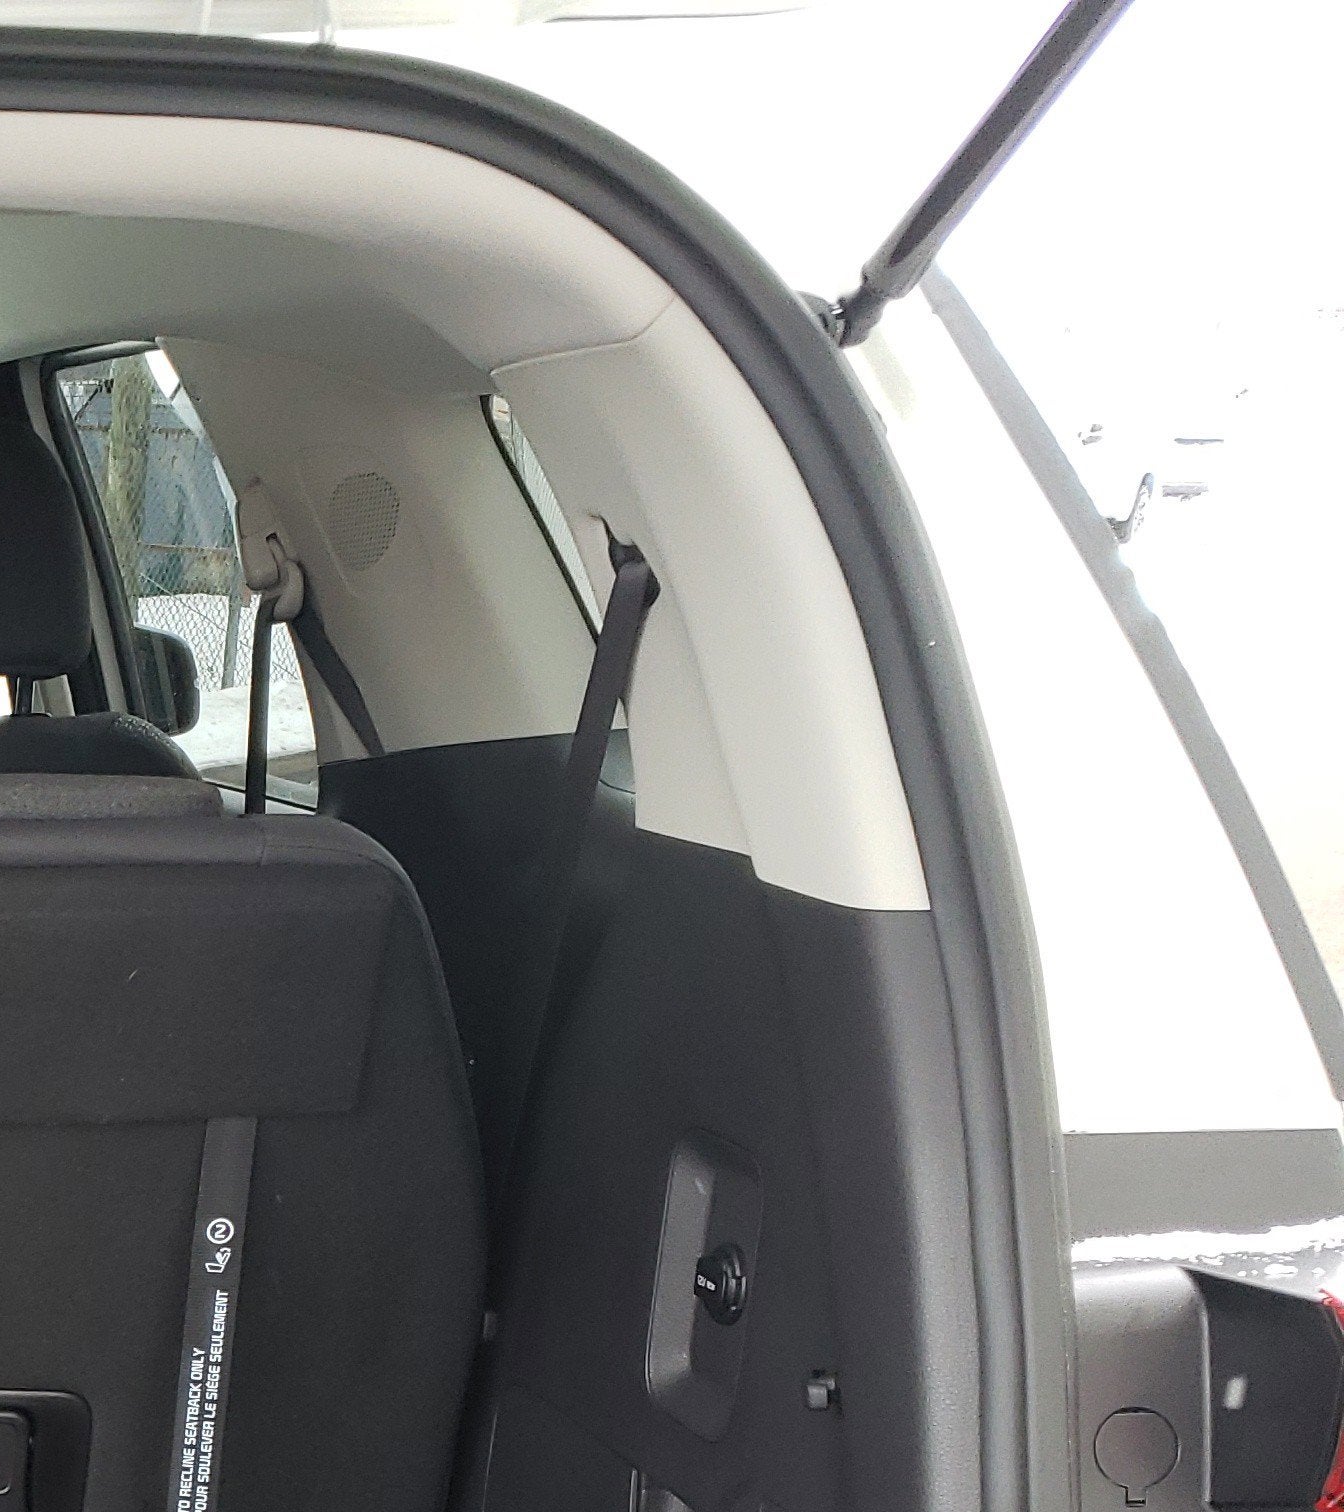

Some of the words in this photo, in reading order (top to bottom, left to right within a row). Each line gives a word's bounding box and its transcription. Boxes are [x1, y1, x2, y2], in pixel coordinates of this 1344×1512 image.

[209, 1289, 229, 1363] SEULEMENT
[190, 1347, 205, 1380] ONLY
[184, 1383, 202, 1446] SEATBACK
[203, 1402, 217, 1419] LE
[179, 1448, 195, 1497] RECLINE
[197, 1421, 215, 1483] SOULEVER
